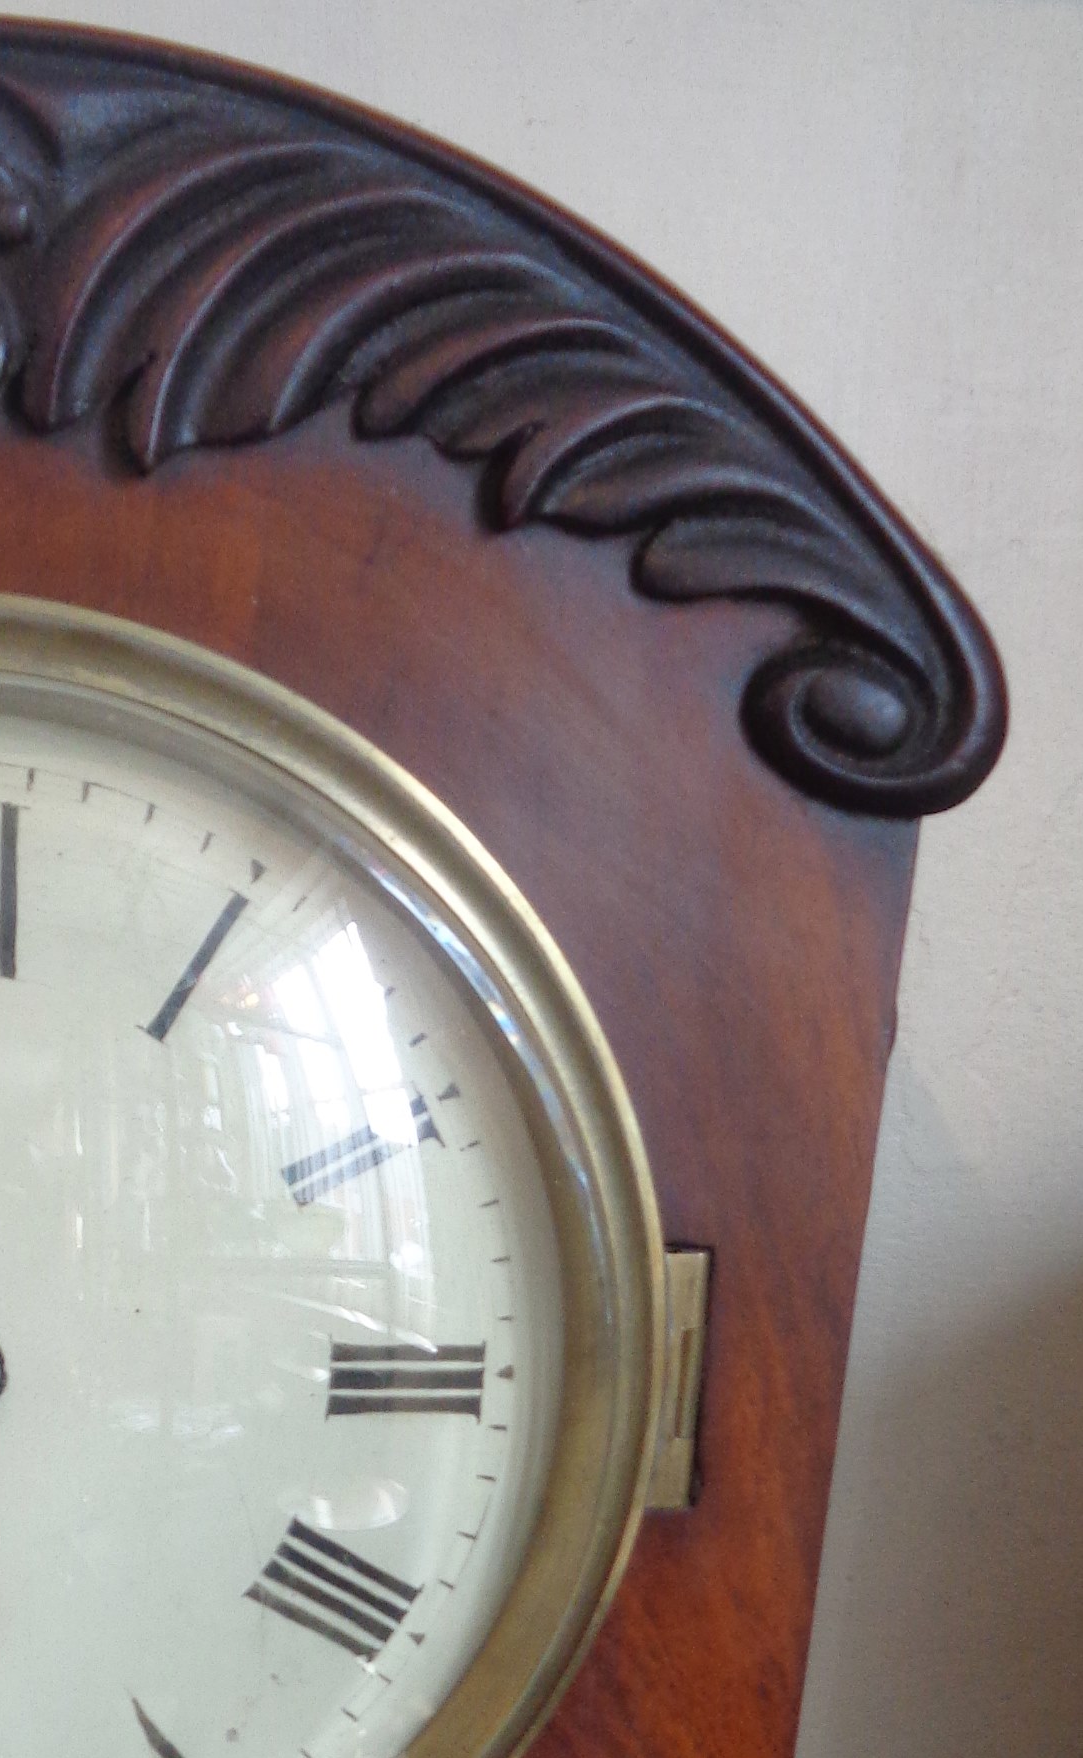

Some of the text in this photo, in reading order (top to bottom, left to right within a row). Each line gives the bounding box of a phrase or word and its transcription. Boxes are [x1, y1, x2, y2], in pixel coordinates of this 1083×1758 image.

[137, 888, 249, 1044] I
[325, 1334, 486, 1423] III
[241, 1518, 425, 1663] IIII
